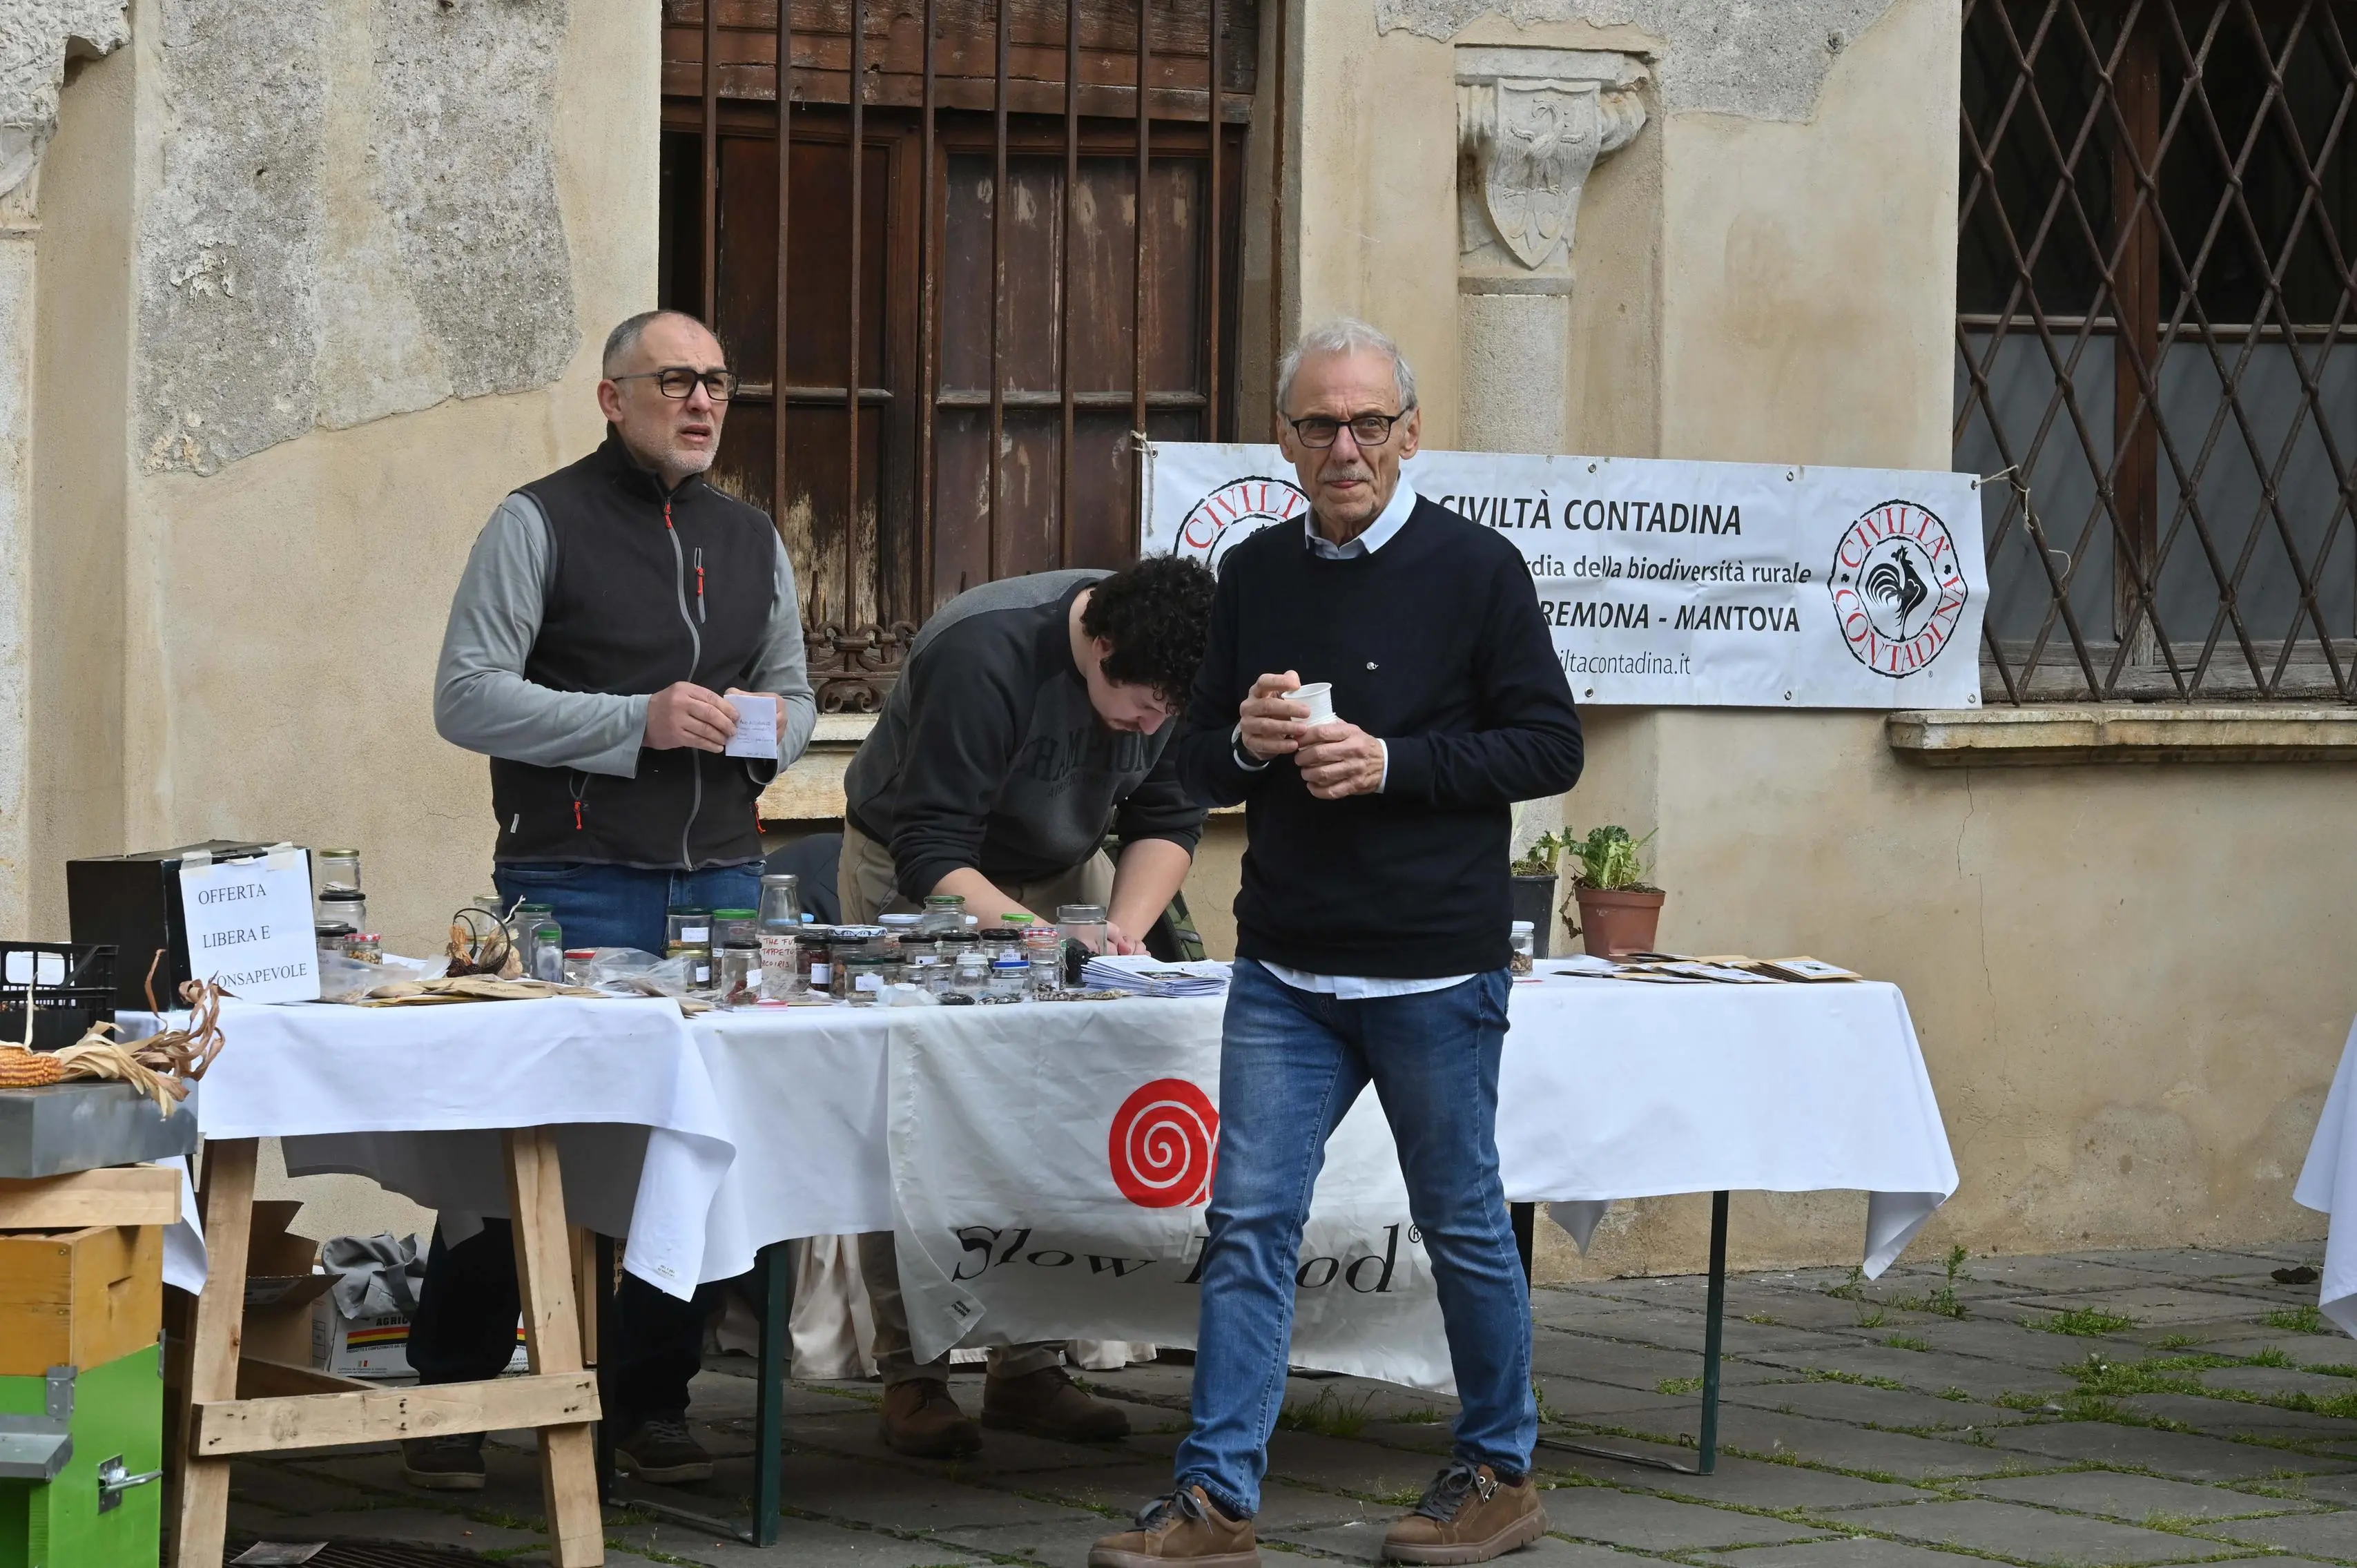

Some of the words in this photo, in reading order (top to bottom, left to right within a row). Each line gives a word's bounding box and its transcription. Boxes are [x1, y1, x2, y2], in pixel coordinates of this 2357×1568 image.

[1185, 484, 1304, 549] CIVILT
[1564, 499, 1741, 536] CONTADINA
[1573, 555, 1622, 579] della
[1627, 556, 1745, 582] biodiversità
[1752, 562, 1812, 583] rurale
[1540, 600, 1649, 629] REMONA
[1674, 605, 1801, 632] MANTOVA
[1835, 574, 1965, 673] CONTADINA
[1559, 649, 1691, 675] iltacontadina.it
[198, 883, 267, 905] OFFERTA
[203, 928, 258, 949] LIBERA
[260, 925, 271, 940] E
[214, 962, 307, 989] ONSAPEVOLE
[951, 1226, 1158, 1283] Slow
[376, 1316, 409, 1326] AGRIC
